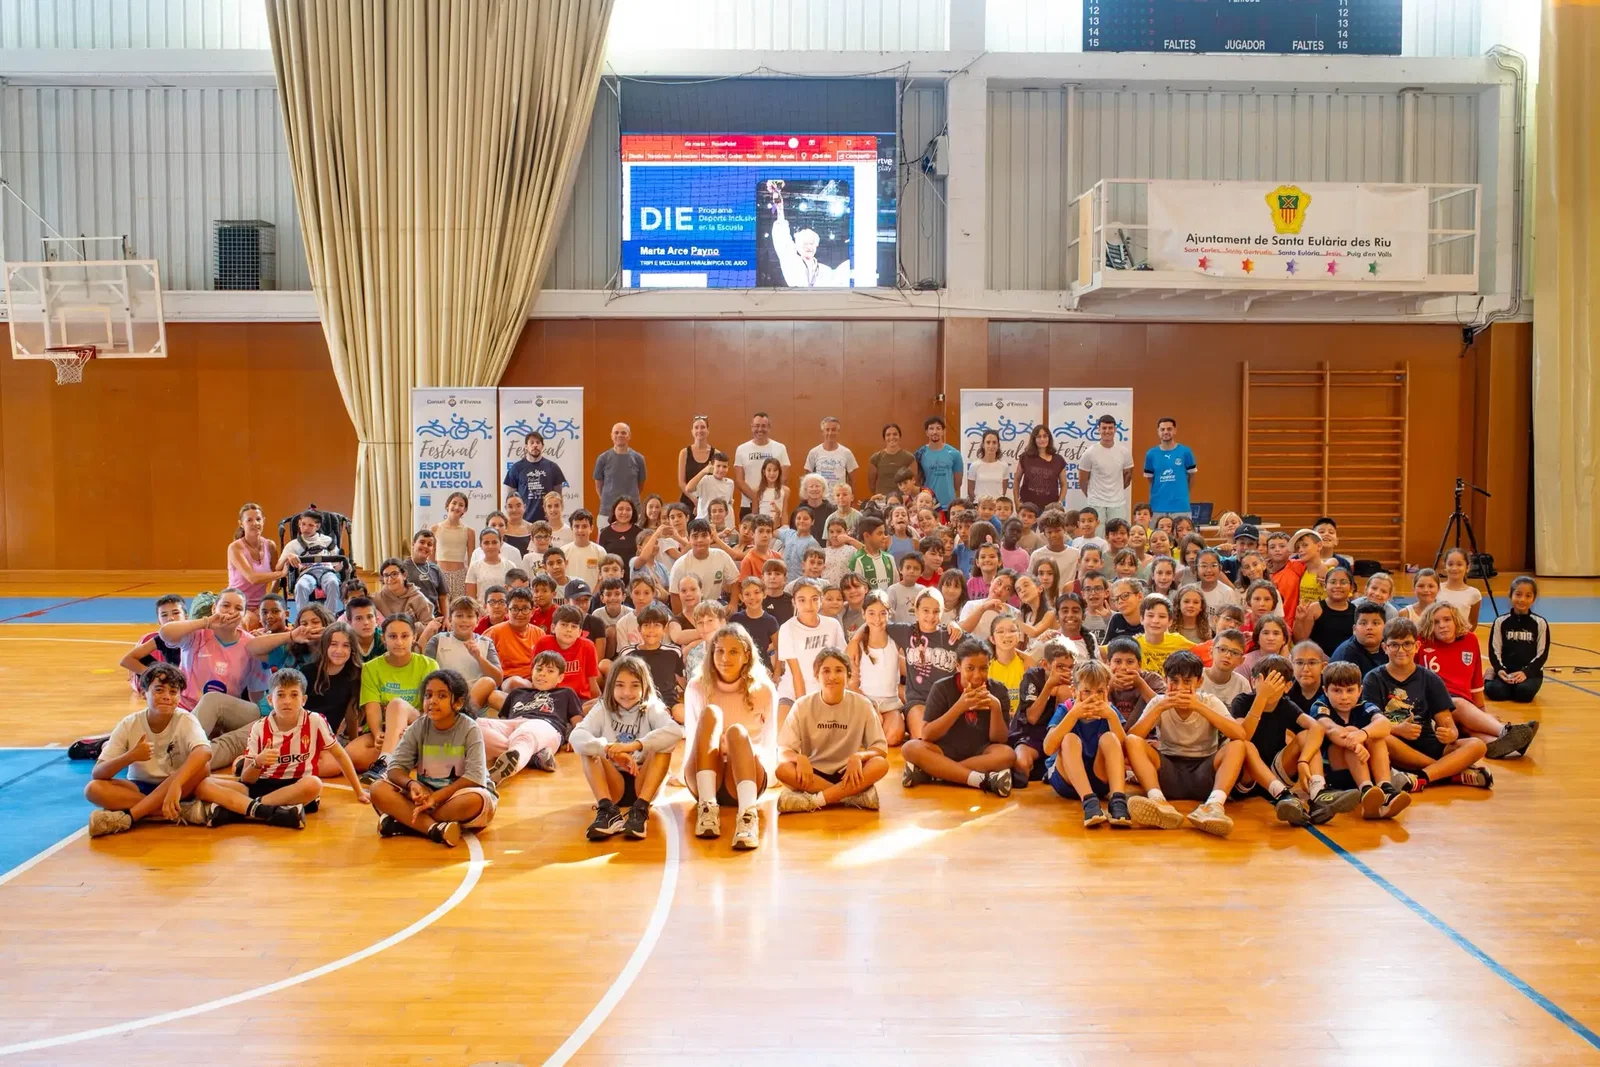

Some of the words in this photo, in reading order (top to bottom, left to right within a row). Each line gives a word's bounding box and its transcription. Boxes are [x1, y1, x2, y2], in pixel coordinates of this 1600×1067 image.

[1088, 6, 1100, 15] 12
[1338, 8, 1349, 17] 12
[1088, 17, 1100, 25] 13
[1338, 19, 1349, 27] 13
[1088, 28, 1100, 36] 14
[1338, 30, 1348, 38] 14
[1088, 38, 1100, 47] 15
[1164, 39, 1196, 50] FALTES
[1225, 40, 1265, 50] JUGADOR
[1292, 40, 1324, 51] FALTES
[1337, 41, 1348, 49] 15
[877, 158, 892, 166] rtve
[698, 207, 733, 216] Programa
[640, 206, 694, 231] DIE
[699, 215, 727, 223] Deporte
[1185, 233, 1251, 245] Ajuntament
[1254, 234, 1268, 245] de
[1271, 235, 1304, 247] Santa
[1308, 236, 1347, 247] Eulària
[1351, 237, 1370, 247] des
[1374, 237, 1391, 248] Riu
[640, 246, 665, 255] Marta
[667, 247, 689, 255] Arce
[691, 246, 719, 257] Payno
[419, 437, 479, 460] Festival
[419, 462, 465, 470] ESPORT
[419, 471, 471, 480] INCLUSIU
[419, 481, 428, 489] A
[431, 481, 483, 489] L'ESCOLA
[1423, 655, 1440, 673] 16
